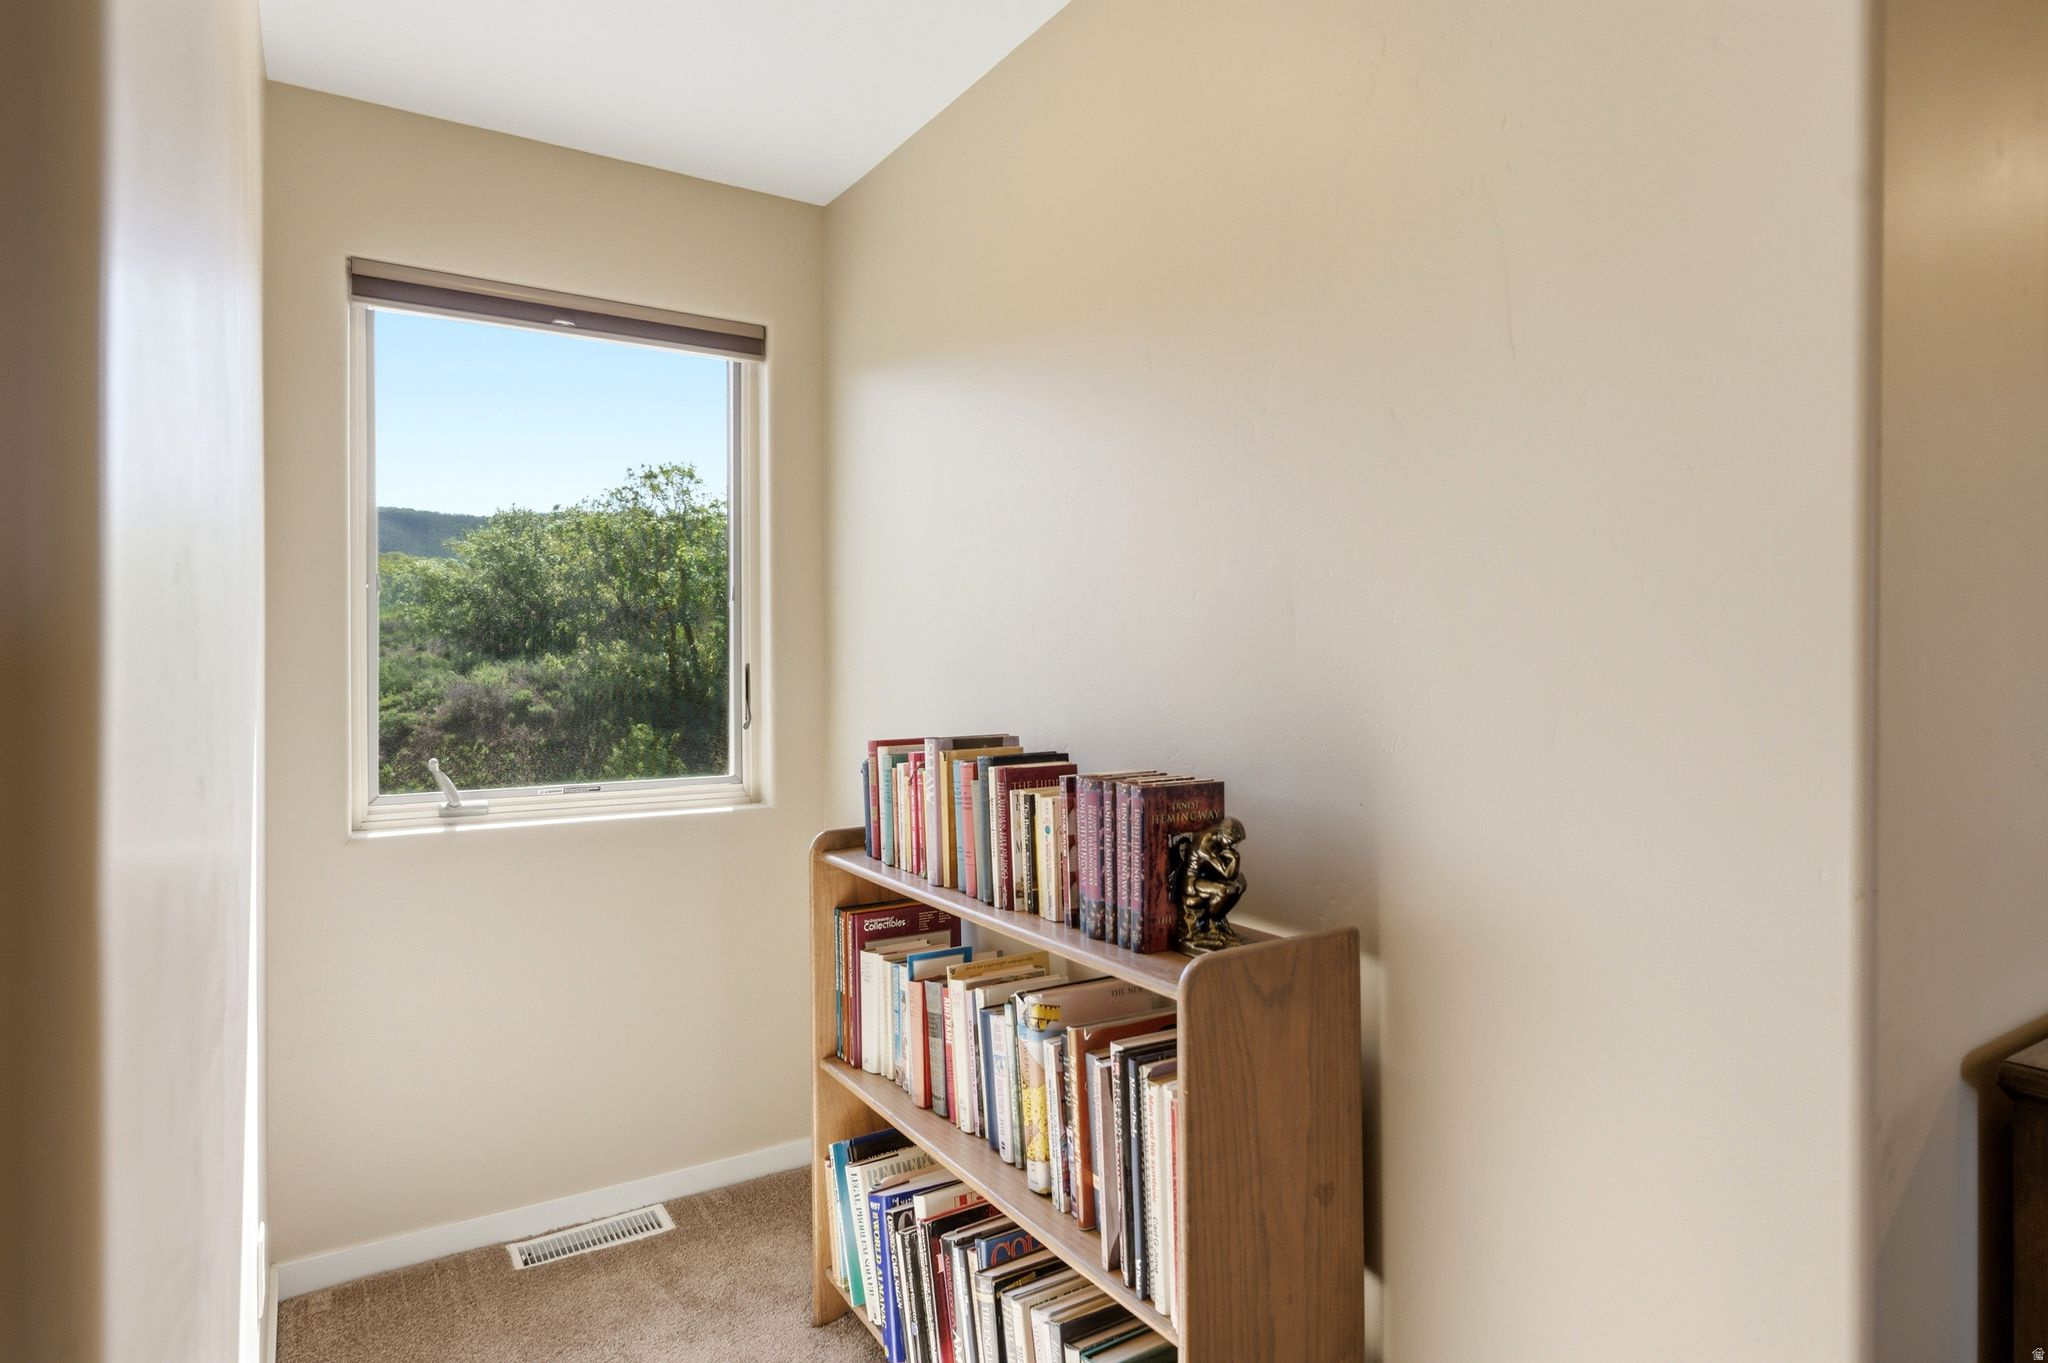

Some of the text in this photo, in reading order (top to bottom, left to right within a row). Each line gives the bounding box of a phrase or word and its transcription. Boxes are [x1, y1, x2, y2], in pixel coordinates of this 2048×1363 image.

[926, 743, 934, 804] SHAW
[1151, 809, 1220, 825] HEMINGWAY
[1172, 801, 1199, 811] ERNEST
[1105, 835, 1113, 898] HEMINGWAY
[1133, 841, 1141, 903] HEMINGWAY
[863, 919, 906, 932] Collectibles
[1111, 989, 1126, 998] THE
[851, 1173, 875, 1297] LEGAL PROBLEM SOLVER
[1152, 1216, 1160, 1238] Carl
[872, 1219, 887, 1330] WORLD ALMANAC
[887, 1214, 903, 1310] COSMOS CARL SAGAN
[1152, 1248, 1160, 1275] Jung
[982, 1307, 991, 1327] THE
